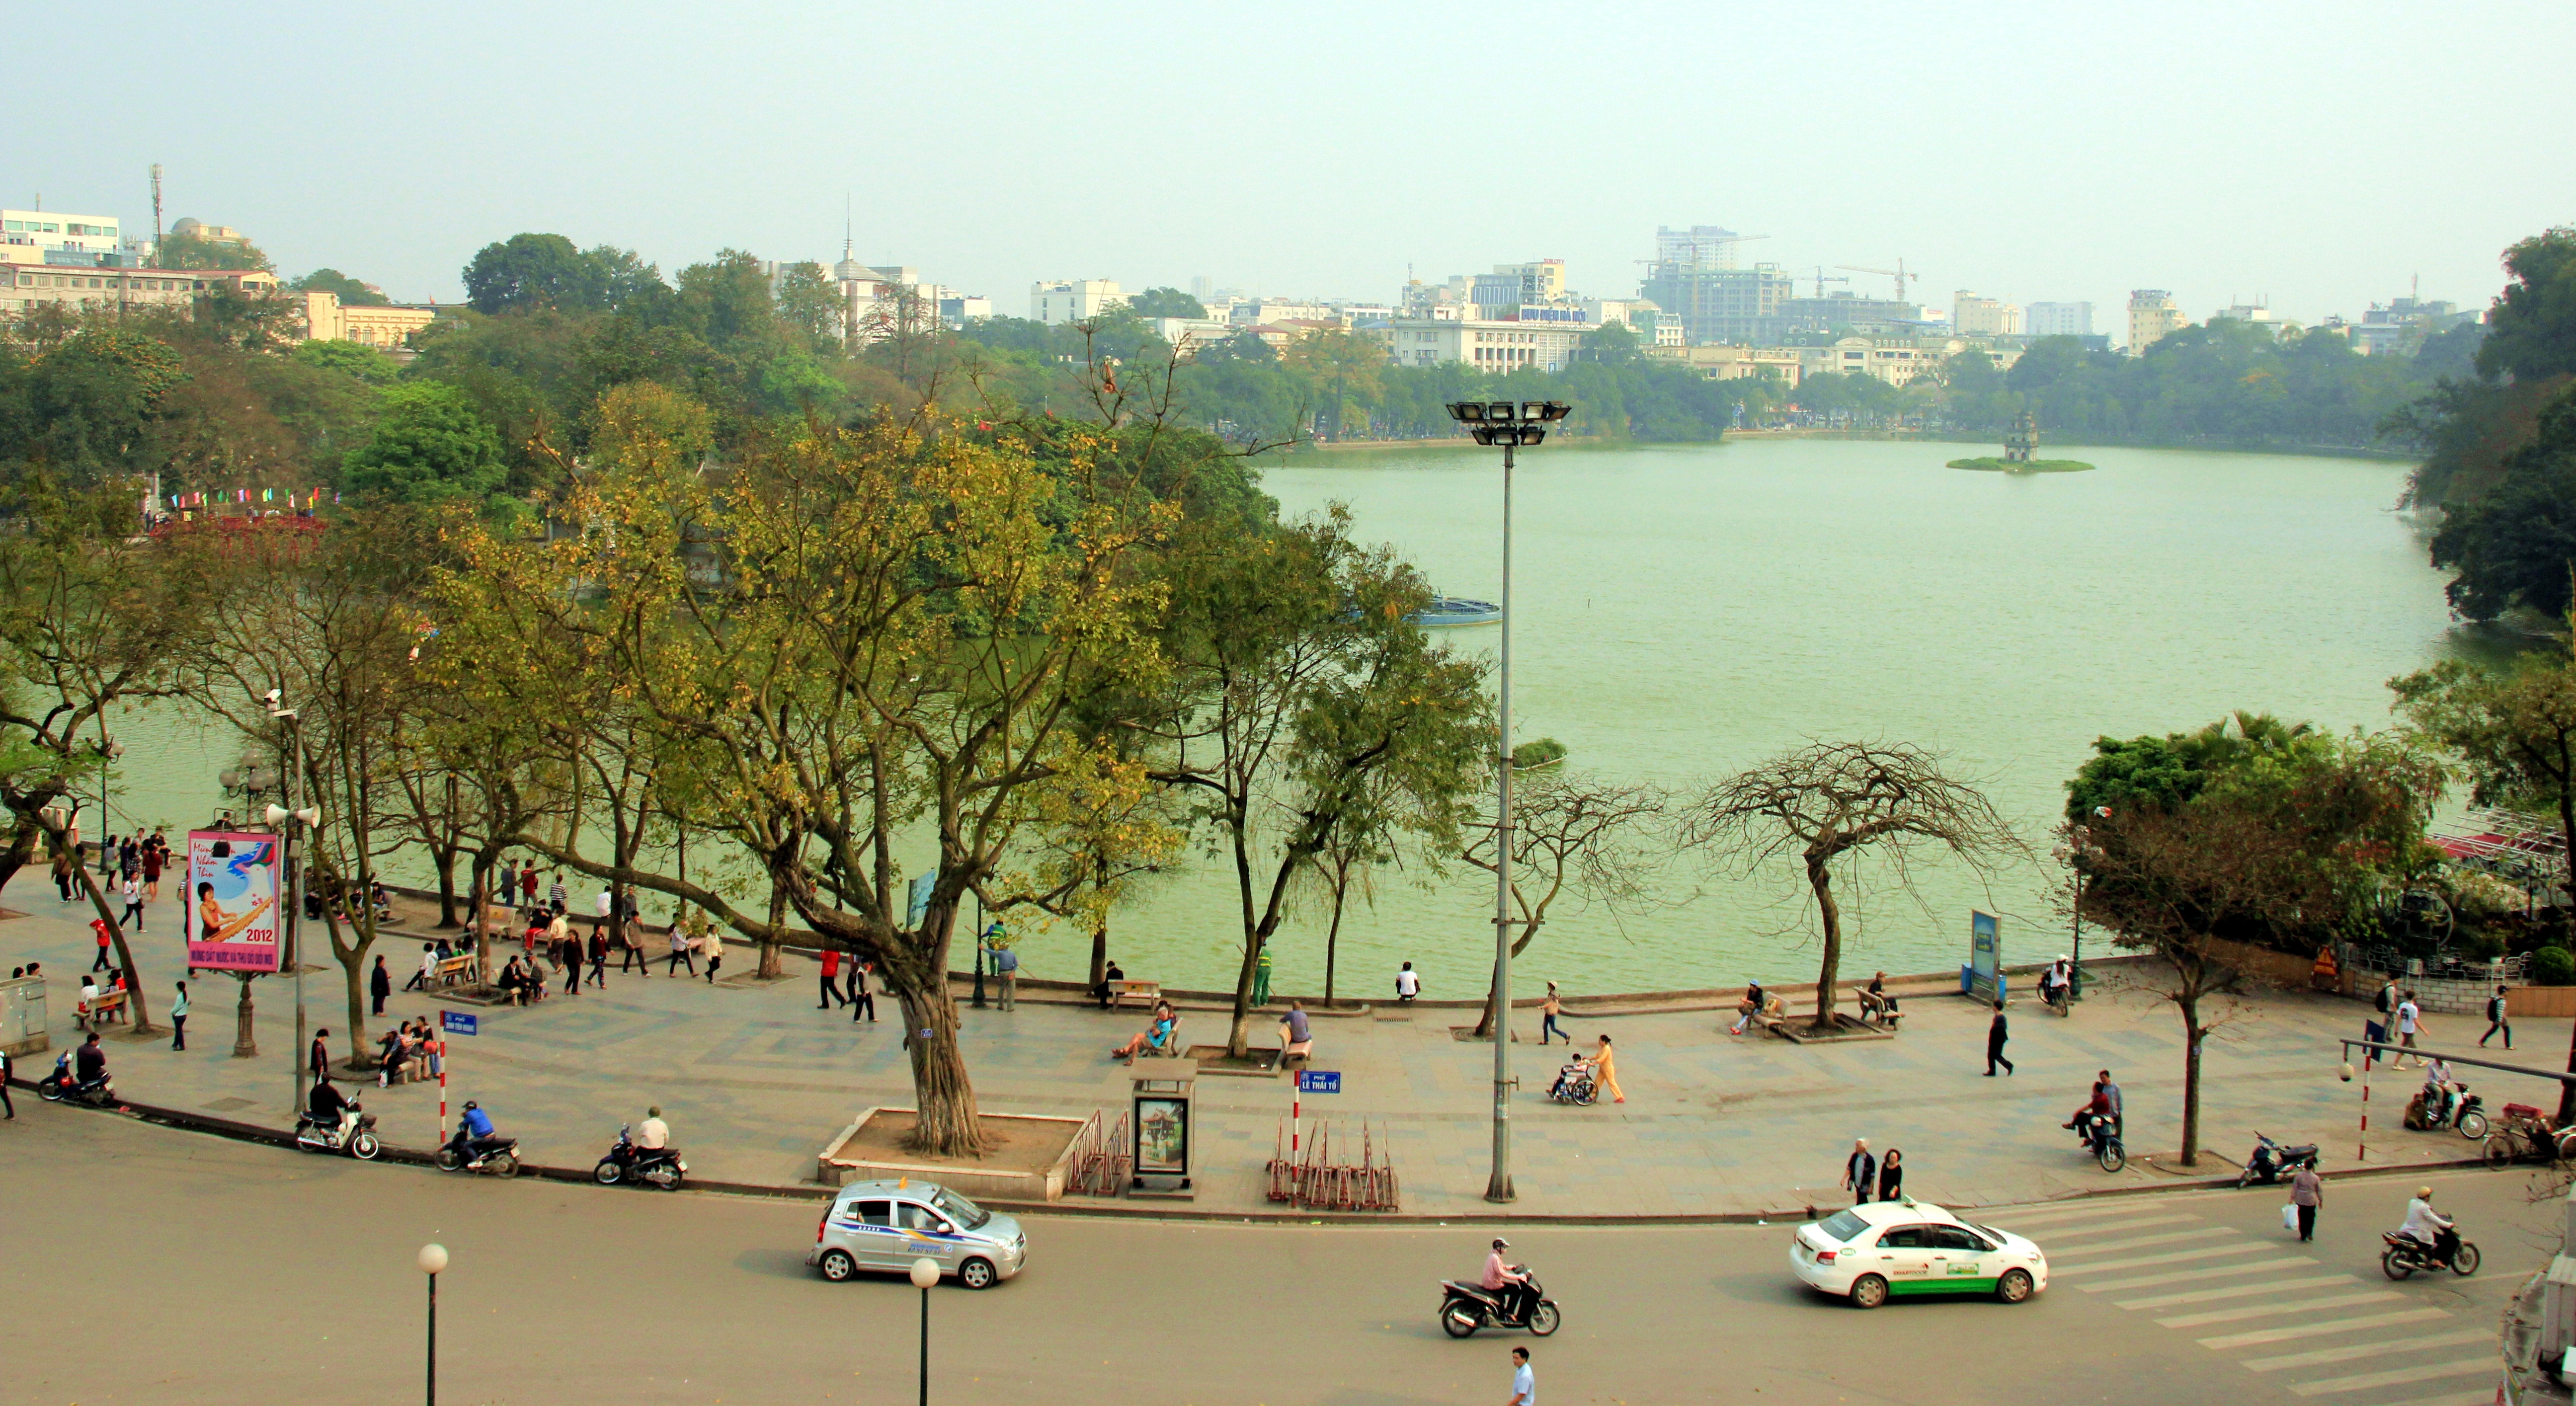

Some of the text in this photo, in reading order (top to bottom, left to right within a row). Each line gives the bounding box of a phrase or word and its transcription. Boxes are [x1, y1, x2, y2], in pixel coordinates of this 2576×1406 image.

[246, 929, 272, 942] 2012
[1302, 1079, 1337, 1090] LÊ THÁI TỔ
